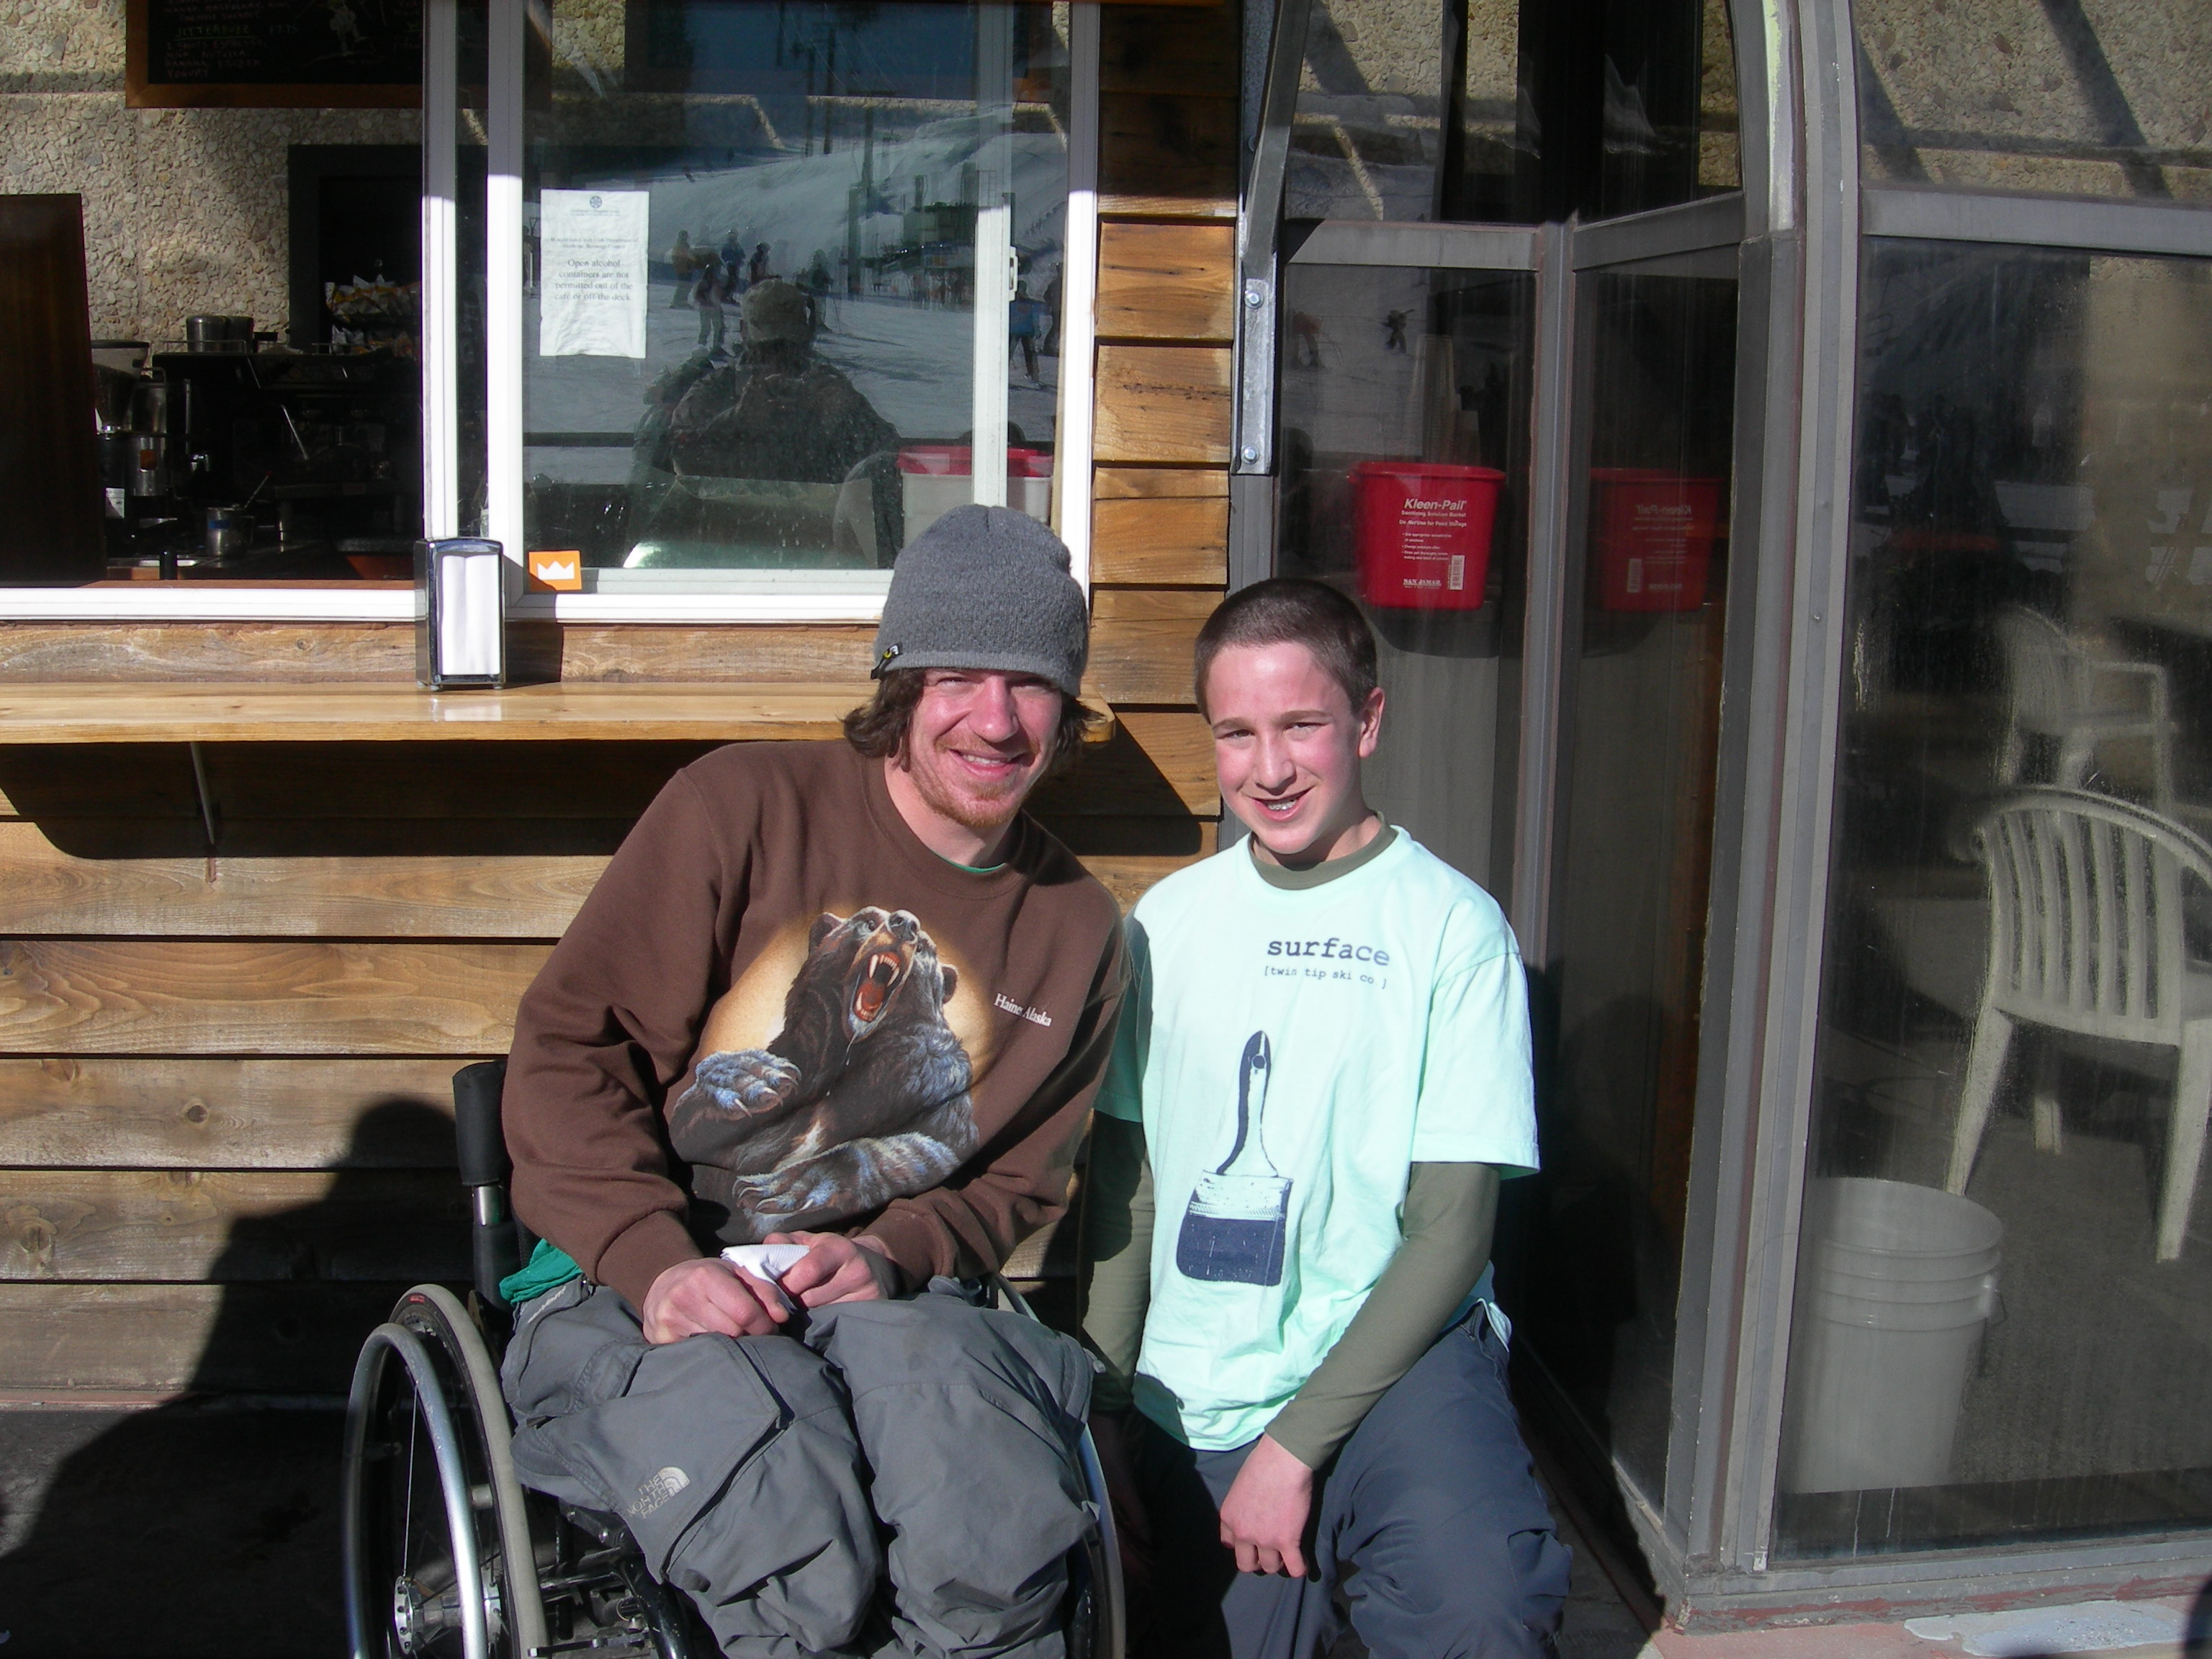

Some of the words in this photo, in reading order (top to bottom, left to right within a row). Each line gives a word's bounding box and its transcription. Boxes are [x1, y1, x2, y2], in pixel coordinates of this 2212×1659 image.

[567, 258, 590, 269] Open
[591, 258, 621, 267] alcohol
[555, 282, 593, 291] permitted
[583, 292, 596, 301] off
[598, 292, 611, 301] the
[1404, 498, 1465, 511] Kleen-Pail
[1267, 938, 1390, 966] surface
[1305, 968, 1326, 980] tip
[1332, 970, 1352, 980] ski
[994, 992, 1024, 1016] Haine
[1022, 1006, 1052, 1028] Alaska
[637, 1473, 662, 1495] THE
[627, 1482, 667, 1517] NORTH
[640, 1491, 670, 1519] FACE
